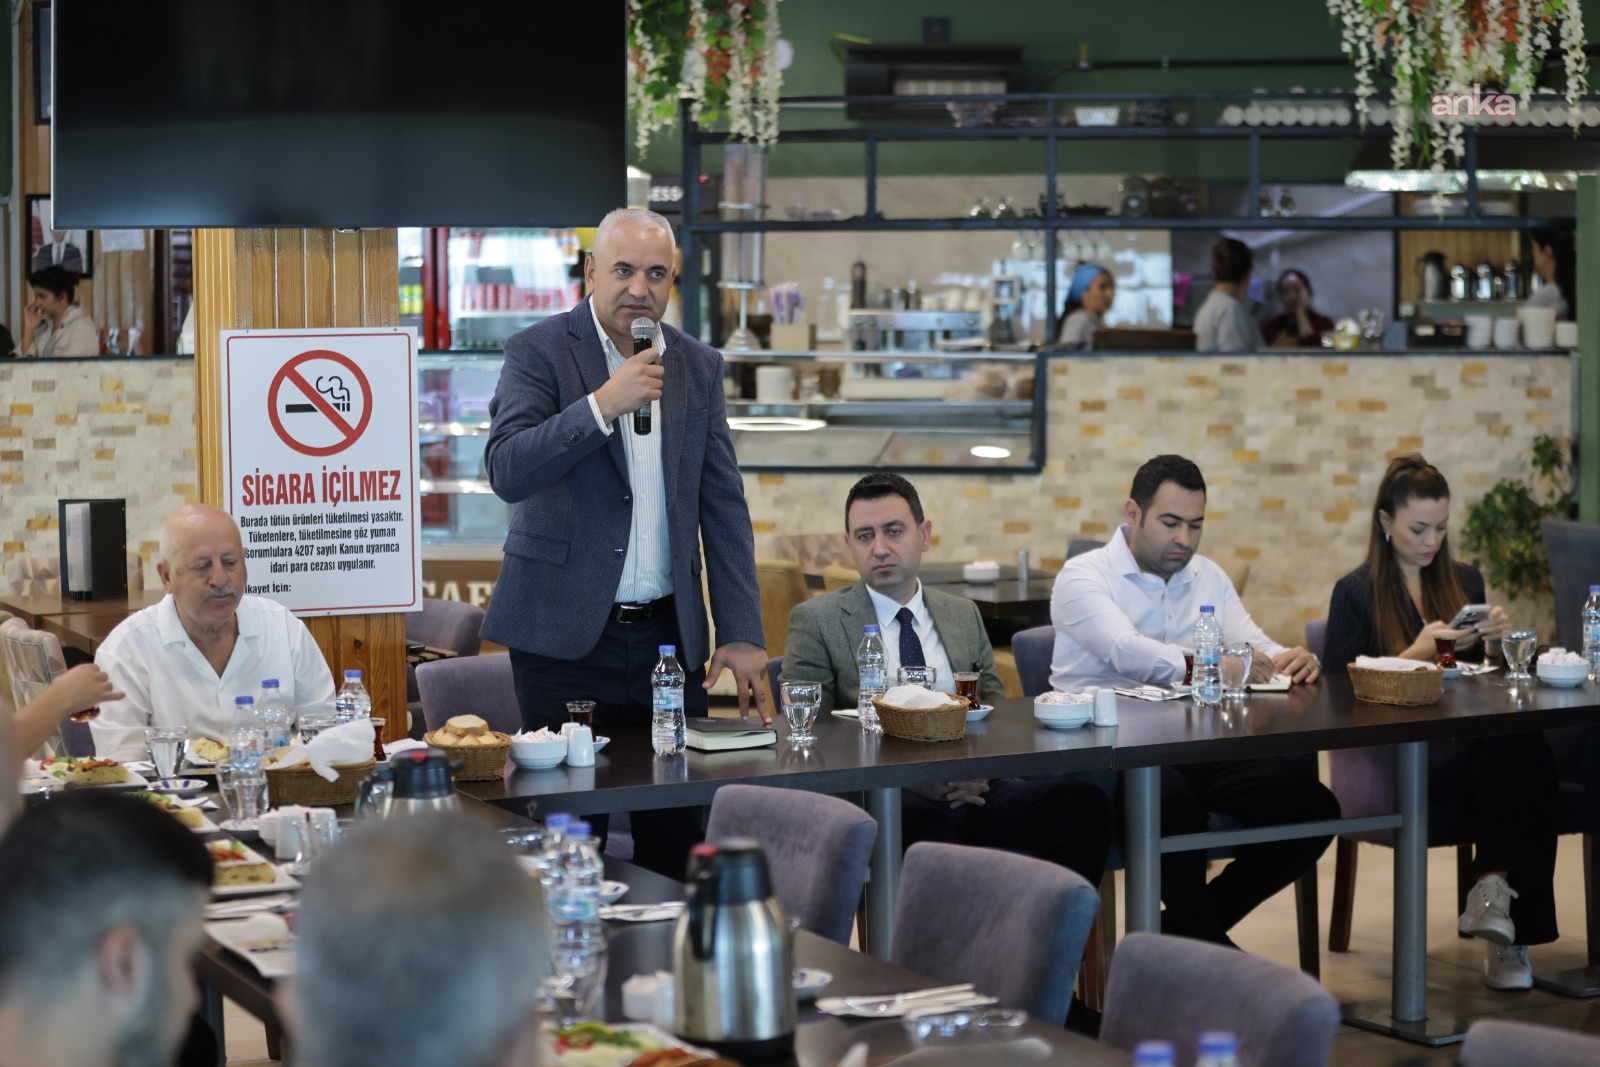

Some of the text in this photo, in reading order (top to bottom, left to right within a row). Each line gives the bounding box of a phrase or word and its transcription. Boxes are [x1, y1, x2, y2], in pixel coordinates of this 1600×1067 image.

[242, 464, 401, 507] SİGARA İÇİLMEZ
[240, 510, 404, 528] Burada tütün ürünleri tüketilmesi yasaktır.
[249, 527, 396, 543] Tüketenlere, tüketilmesine göz yuman
[246, 543, 400, 558] sorumlulara 4207 sayılı Kanun uyarınca
[270, 558, 376, 574] idari para cezası uygulanır.
[245, 582, 291, 594] ikayet İçin:
